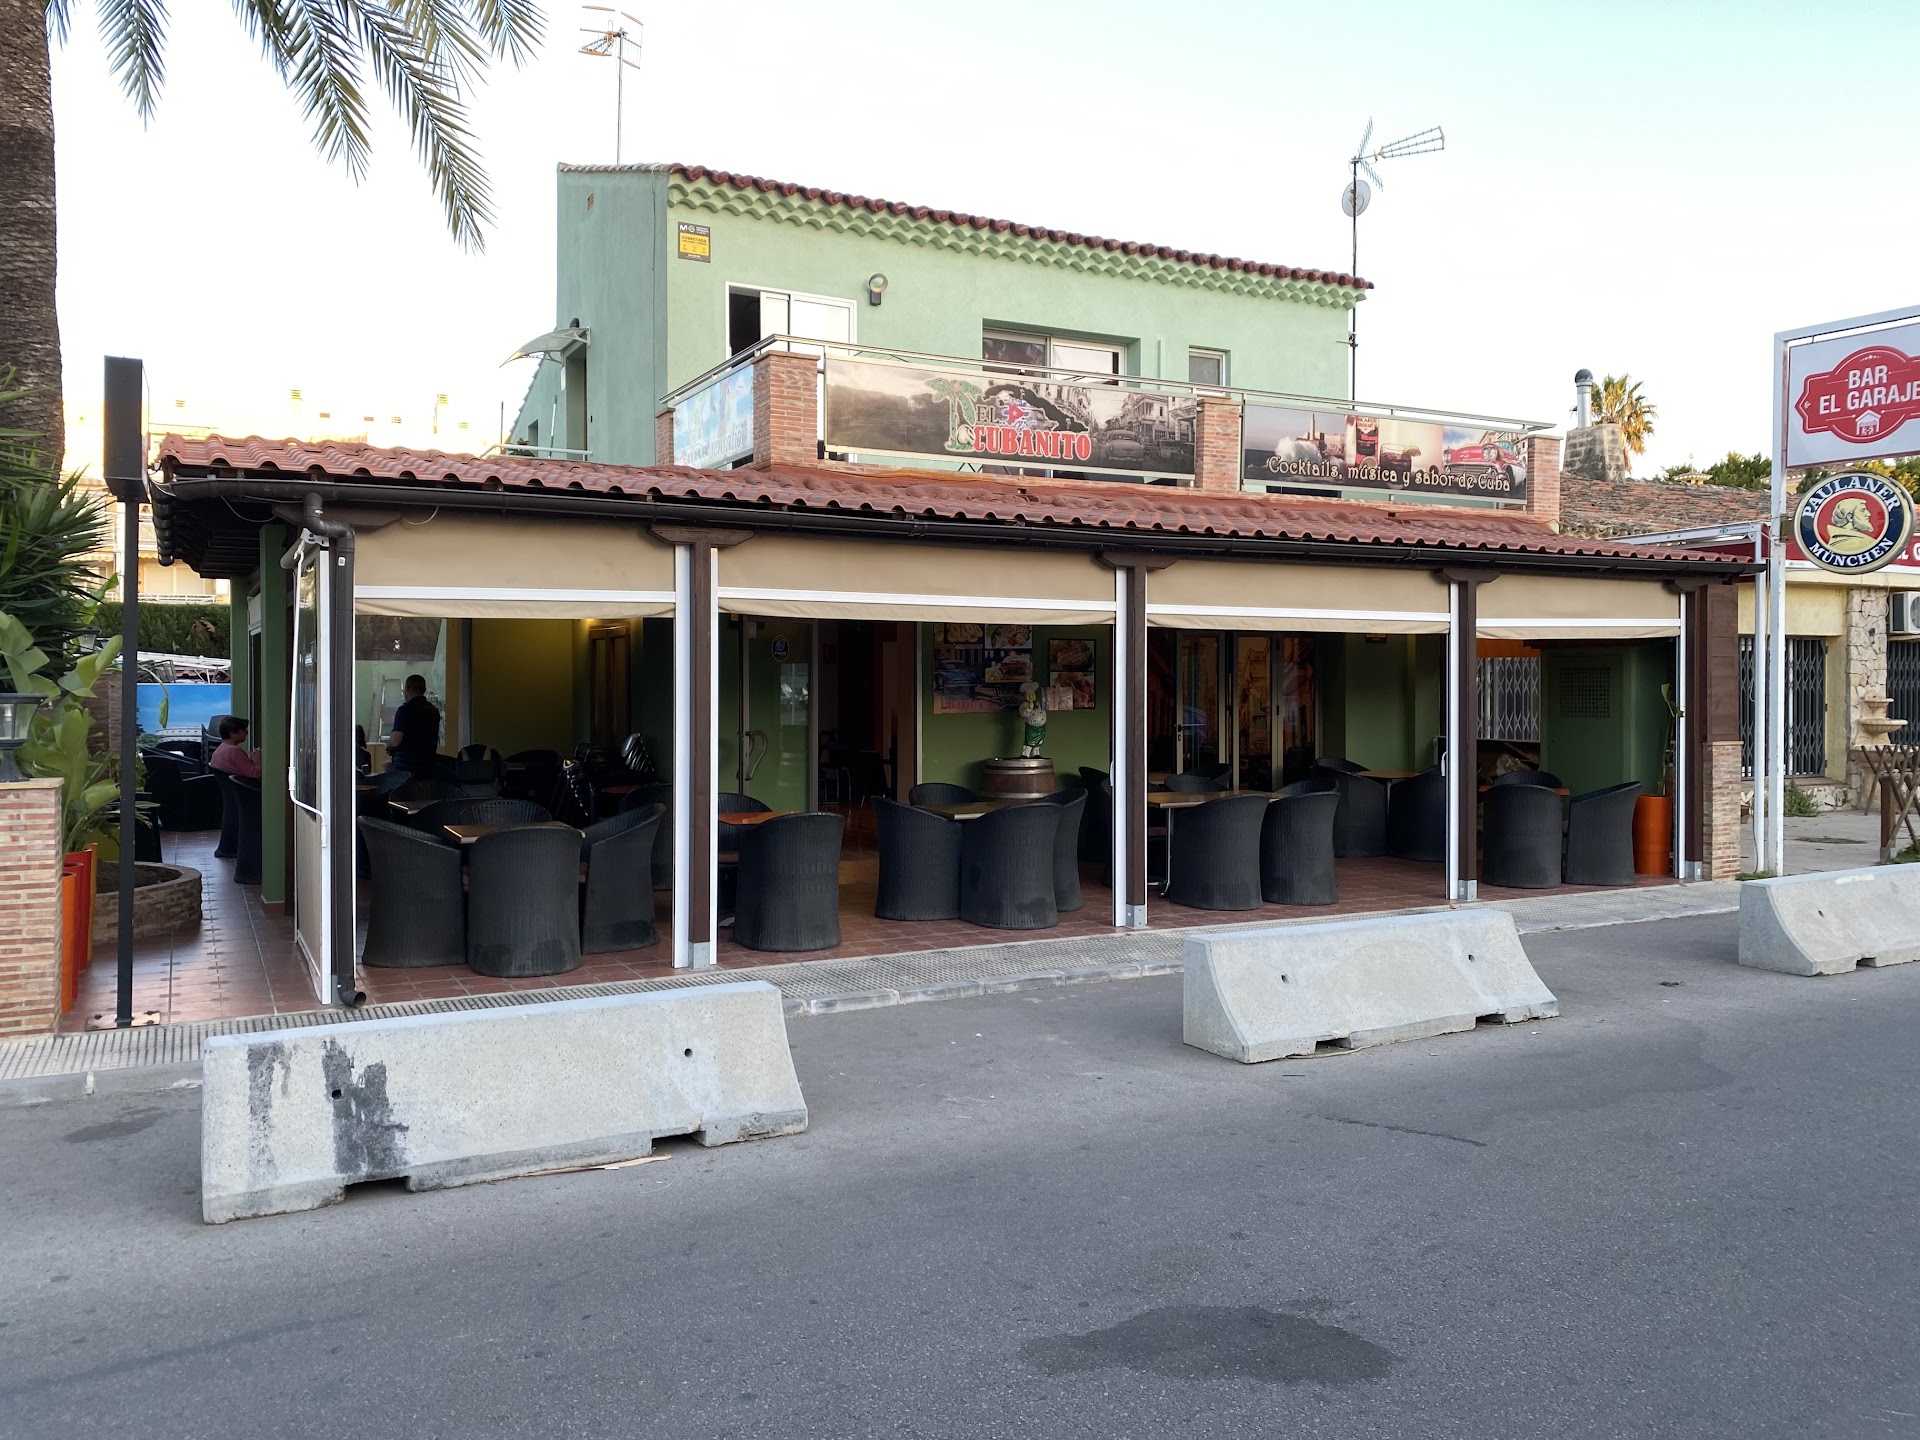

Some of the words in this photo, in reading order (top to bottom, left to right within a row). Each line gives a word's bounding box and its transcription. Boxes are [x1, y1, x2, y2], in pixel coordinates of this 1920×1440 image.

[1848, 364, 1888, 389] BAR
[976, 404, 999, 423] EL
[1819, 394, 1841, 415] EL
[1846, 380, 1920, 411] GARAJE
[973, 425, 1091, 461] CUBANITO
[1267, 455, 1343, 479] Cocktails,
[1347, 464, 1397, 482] música
[1402, 470, 1410, 487] y
[1414, 468, 1455, 487] sabor
[1456, 472, 1475, 489] de
[1478, 472, 1511, 492] Cuba
[1802, 476, 1901, 518] PAULANER
[1809, 537, 1895, 567] MÜNCHEN
